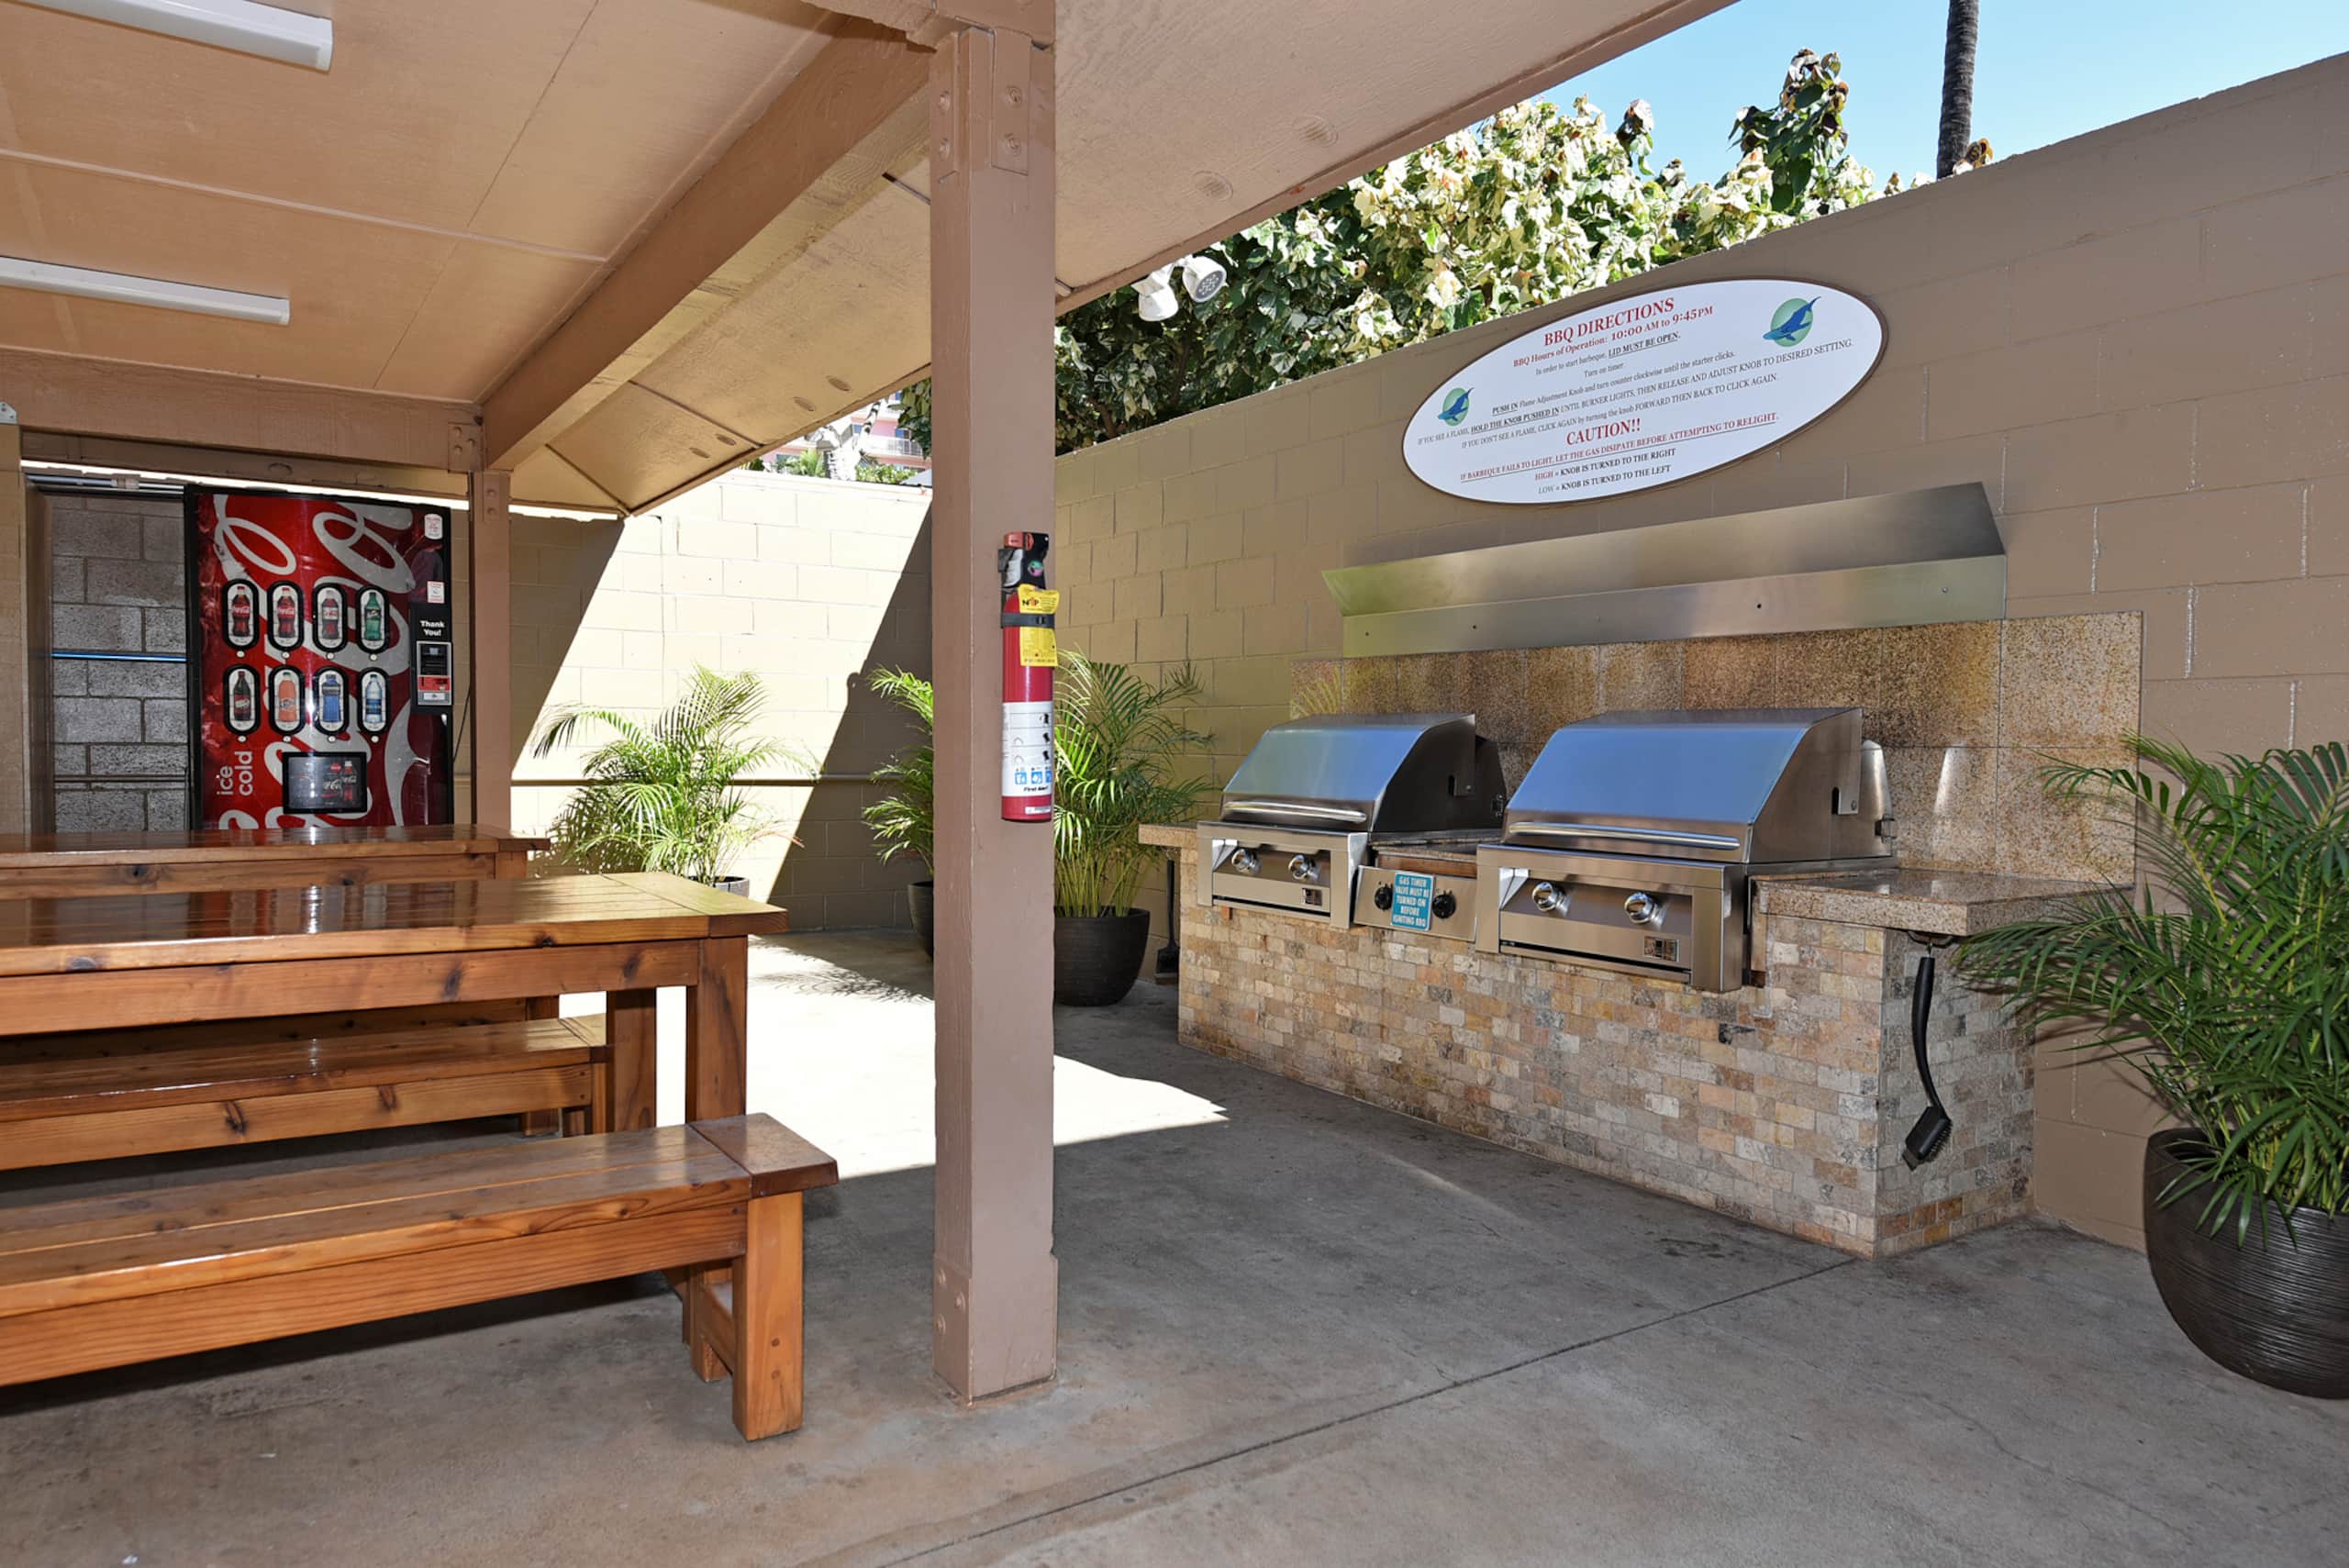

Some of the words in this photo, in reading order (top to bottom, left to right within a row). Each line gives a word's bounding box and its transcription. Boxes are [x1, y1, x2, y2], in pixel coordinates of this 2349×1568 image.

[1543, 327, 1574, 347] BBQ
[1577, 297, 1675, 338] DIRECTIONS
[1513, 355, 1531, 367] BBQ
[1531, 350, 1554, 363] Hours
[1555, 346, 1564, 357] of
[1564, 337, 1608, 356] Operation:
[1611, 326, 1642, 341] 10:00
[1644, 321, 1659, 332] AM
[1661, 318, 1670, 328] to
[1542, 363, 1558, 374] order
[1559, 361, 1565, 369] to
[1565, 357, 1578, 369] start
[1608, 347, 1621, 358] LID
[1622, 341, 1644, 354] MUST
[1645, 339, 1655, 349] BE
[1492, 403, 1510, 415] PUSH
[1510, 402, 1519, 412] IN
[1535, 391, 1568, 405] Adjustment
[1568, 386, 1584, 397] Knob
[1585, 384, 1596, 394] and
[1597, 381, 1609, 391] turn
[1610, 375, 1632, 387] counter
[1633, 369, 1663, 382] clockwise
[1663, 362, 1679, 374] until
[1679, 361, 1691, 371] the
[1691, 355, 1714, 368] starter
[1584, 369, 1598, 378] Turn
[1471, 423, 1489, 435] HOLD
[1489, 420, 1503, 431] THE
[1503, 416, 1523, 428] KNOB
[1523, 409, 1551, 425] PUSHED
[1551, 407, 1560, 418] IN
[1581, 394, 1609, 409] BURNER
[1637, 384, 1657, 396] THEN
[1657, 375, 1690, 392] RELEASE
[1690, 373, 1708, 384] AND
[1709, 365, 1738, 381] ADJUST
[1739, 360, 1762, 373] KNOB
[1763, 356, 1775, 366] TO
[1776, 348, 1813, 364] DESIRED
[1537, 422, 1556, 433] CLICK
[1608, 407, 1619, 417] the
[1619, 404, 1634, 416] knob
[1634, 396, 1671, 412] FORWARD
[1671, 391, 1692, 404] THEN
[1693, 386, 1714, 399] BACK
[1715, 383, 1726, 393] TO
[1726, 377, 1750, 391] CLICK
[1566, 417, 1641, 446] CAUTION!!
[1467, 466, 1502, 481] BARBEQUE
[1501, 462, 1521, 473] FAILS
[1520, 460, 1531, 469] TO
[1555, 452, 1569, 463] LET
[1569, 450, 1585, 461] THE
[1585, 446, 1600, 457] GAS
[1600, 438, 1636, 454] DISIPATE
[1636, 432, 1668, 448] BEFORE
[1668, 422, 1722, 441] ATTEMPTING
[1722, 419, 1734, 429] TO
[1535, 472, 1553, 481] HIGH
[1560, 466, 1581, 476] KNOB
[1581, 464, 1589, 473] IS
[1590, 458, 1622, 472] TURNED
[1621, 456, 1632, 466] TO
[1632, 452, 1651, 463] THE
[1651, 448, 1676, 460] RIGHT
[1538, 485, 1555, 495] LOW
[1561, 481, 1582, 491] KNOB
[1582, 479, 1590, 487] IS
[1591, 473, 1622, 485] TURNED
[1622, 472, 1633, 481] TO
[1633, 466, 1651, 477] THE
[1651, 464, 1671, 474] LEFT
[419, 620, 445, 628] Thank
[423, 628, 441, 637] You!
[216, 765, 233, 795] ice
[235, 751, 253, 796] cold
